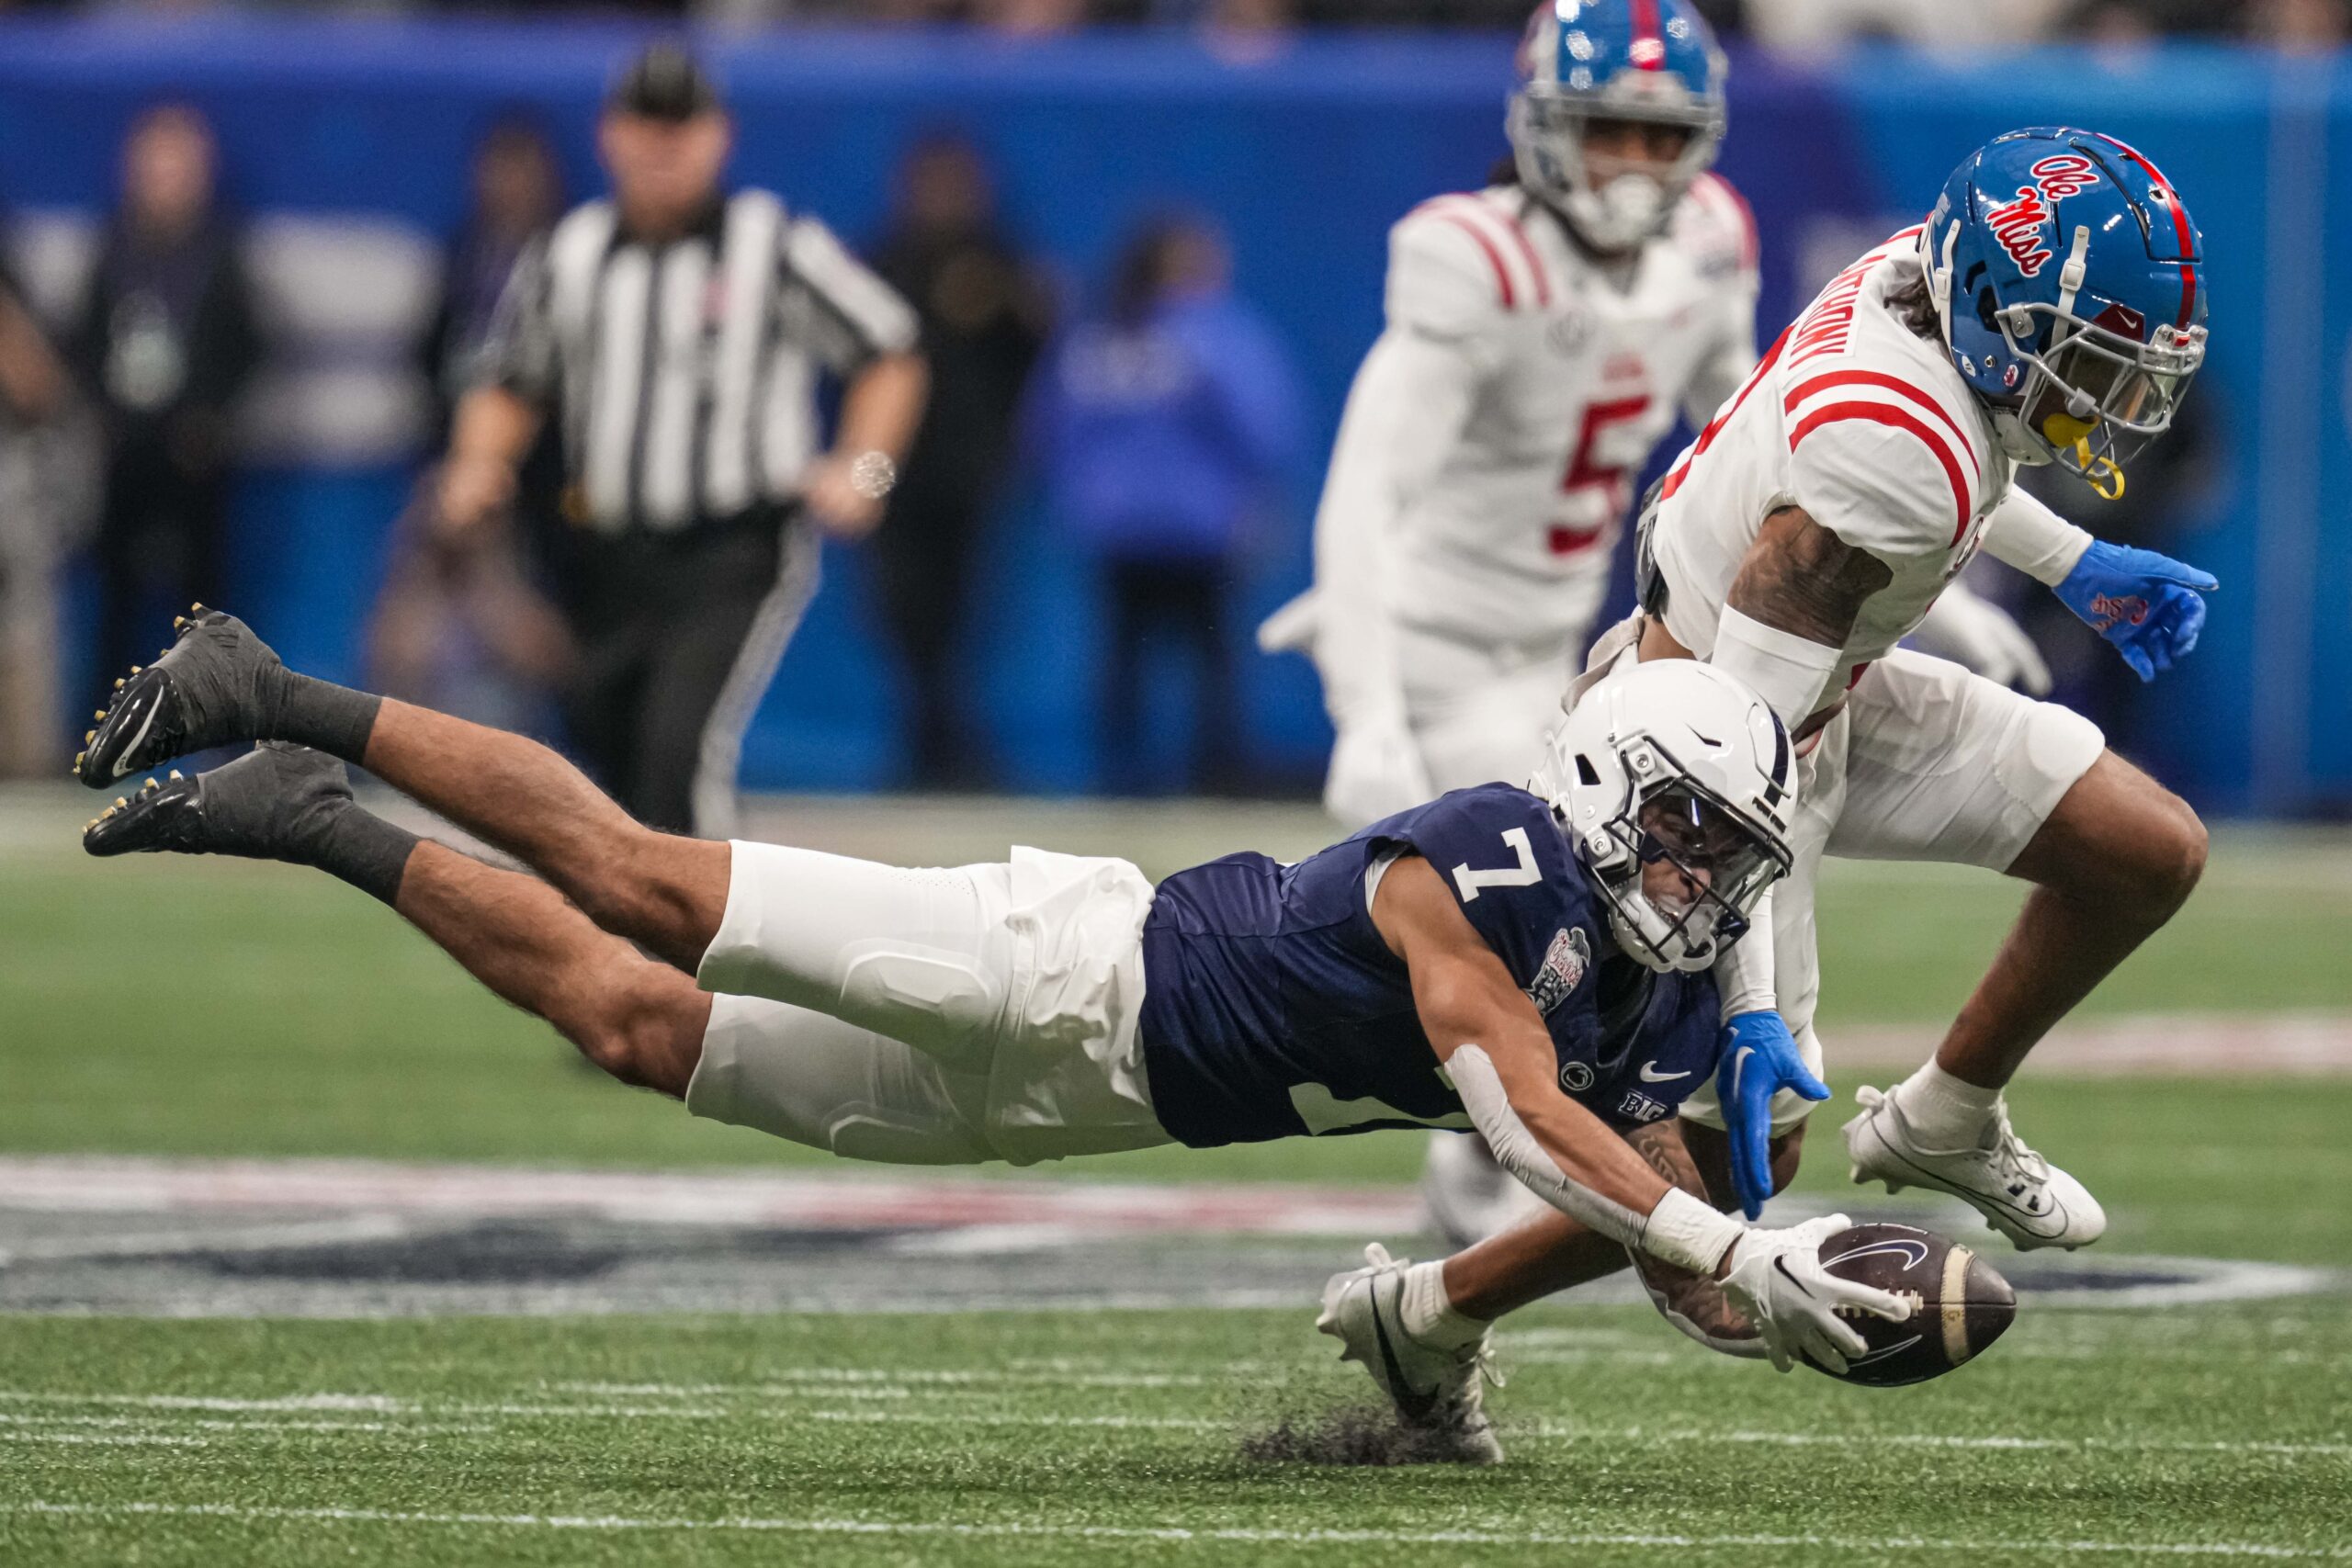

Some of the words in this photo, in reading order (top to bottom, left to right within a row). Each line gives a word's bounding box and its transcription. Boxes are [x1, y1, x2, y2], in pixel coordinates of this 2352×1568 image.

[2030, 154, 2099, 201] Ole
[1984, 186, 2052, 278] Miss
[1546, 392, 1654, 556] 5
[1452, 827, 1543, 903] 7
